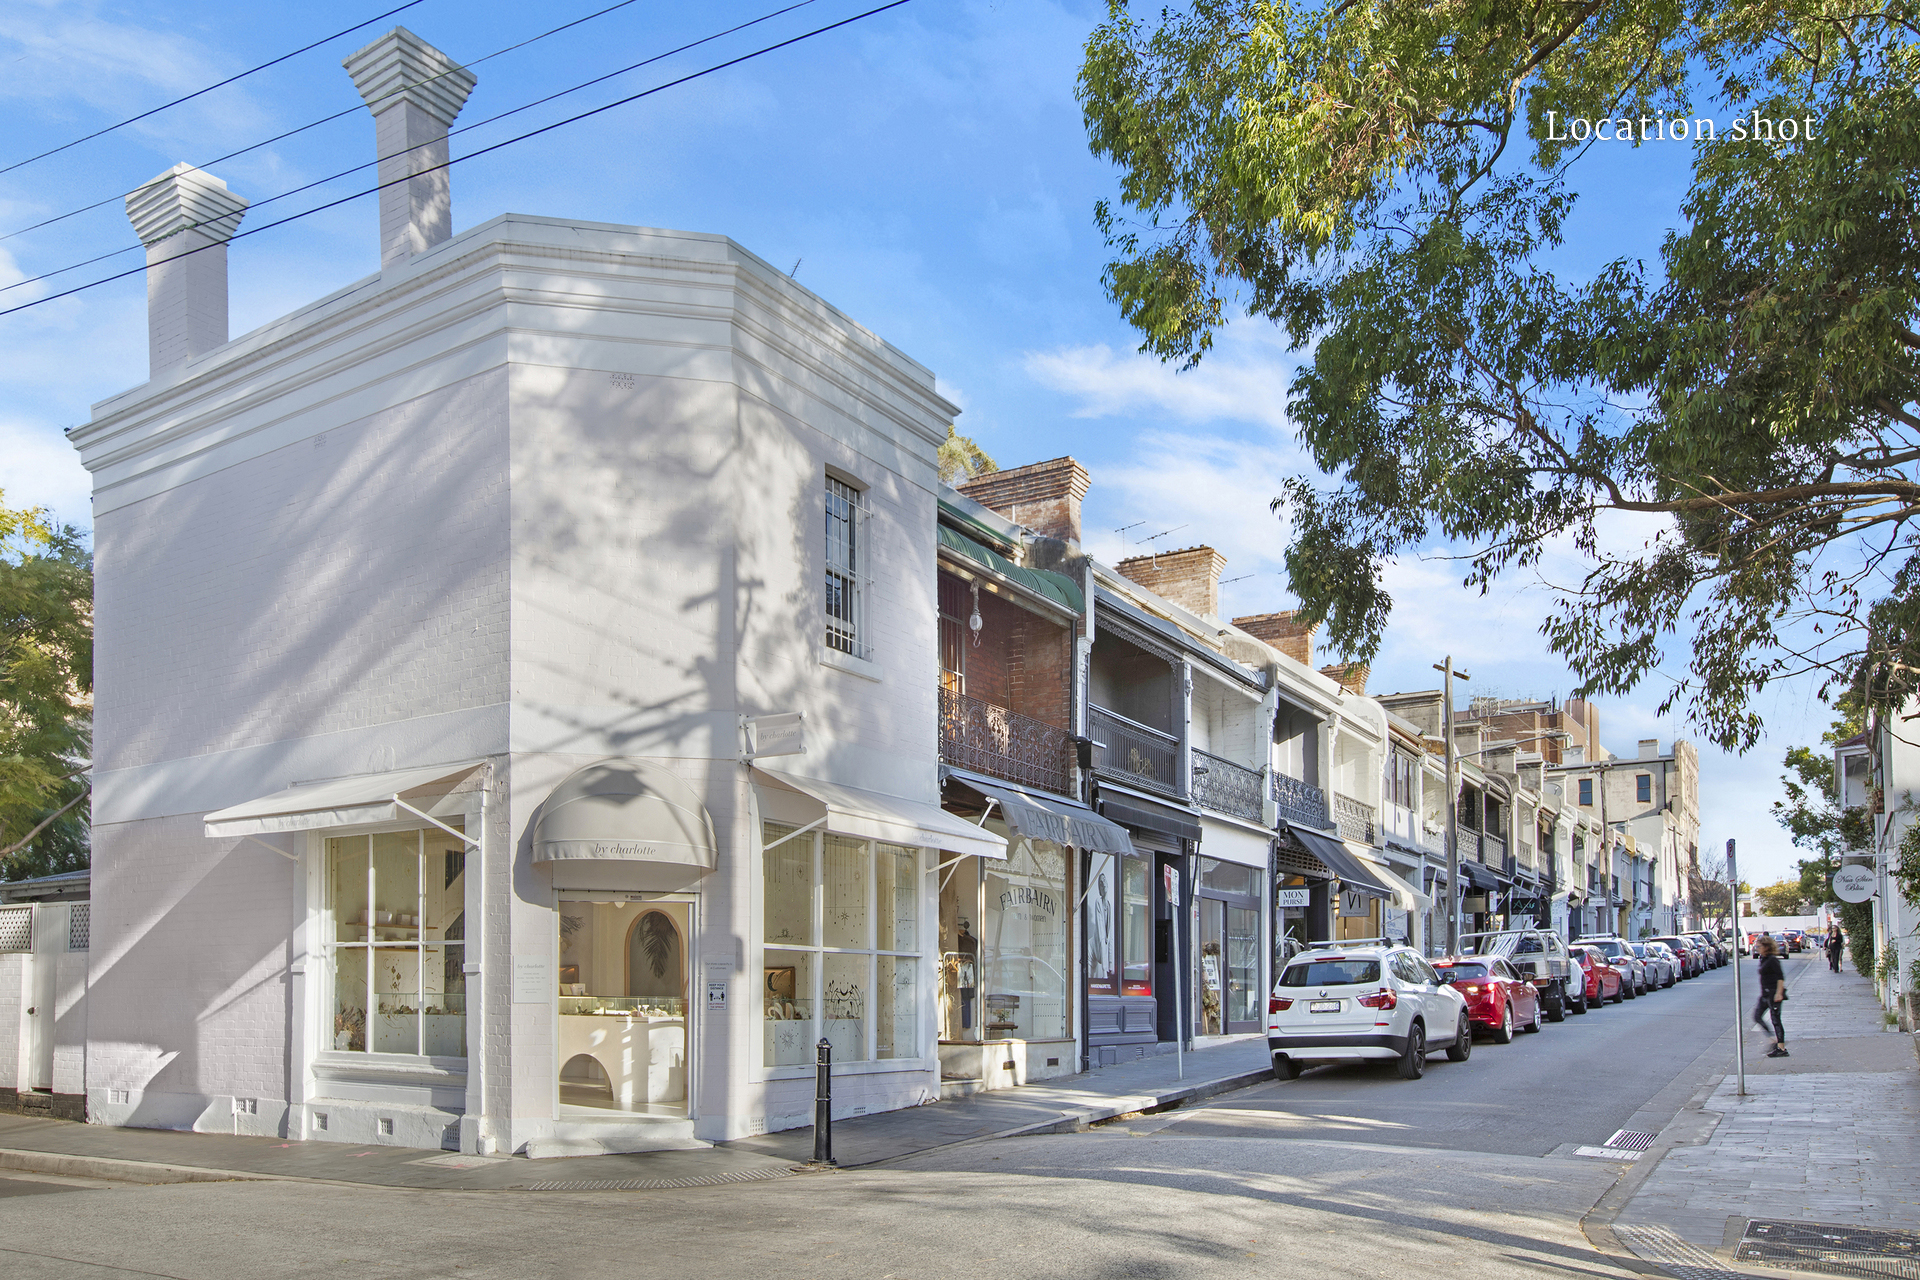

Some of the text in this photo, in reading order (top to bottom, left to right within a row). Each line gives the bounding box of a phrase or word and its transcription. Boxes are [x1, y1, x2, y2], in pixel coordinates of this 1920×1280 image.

[760, 730, 796, 743] by charlotte
[595, 843, 656, 857] by charlotte
[1855, 874, 1873, 883] Skin
[1845, 883, 1864, 891] Bliss
[1000, 888, 1057, 917] FAIRBAIRN
